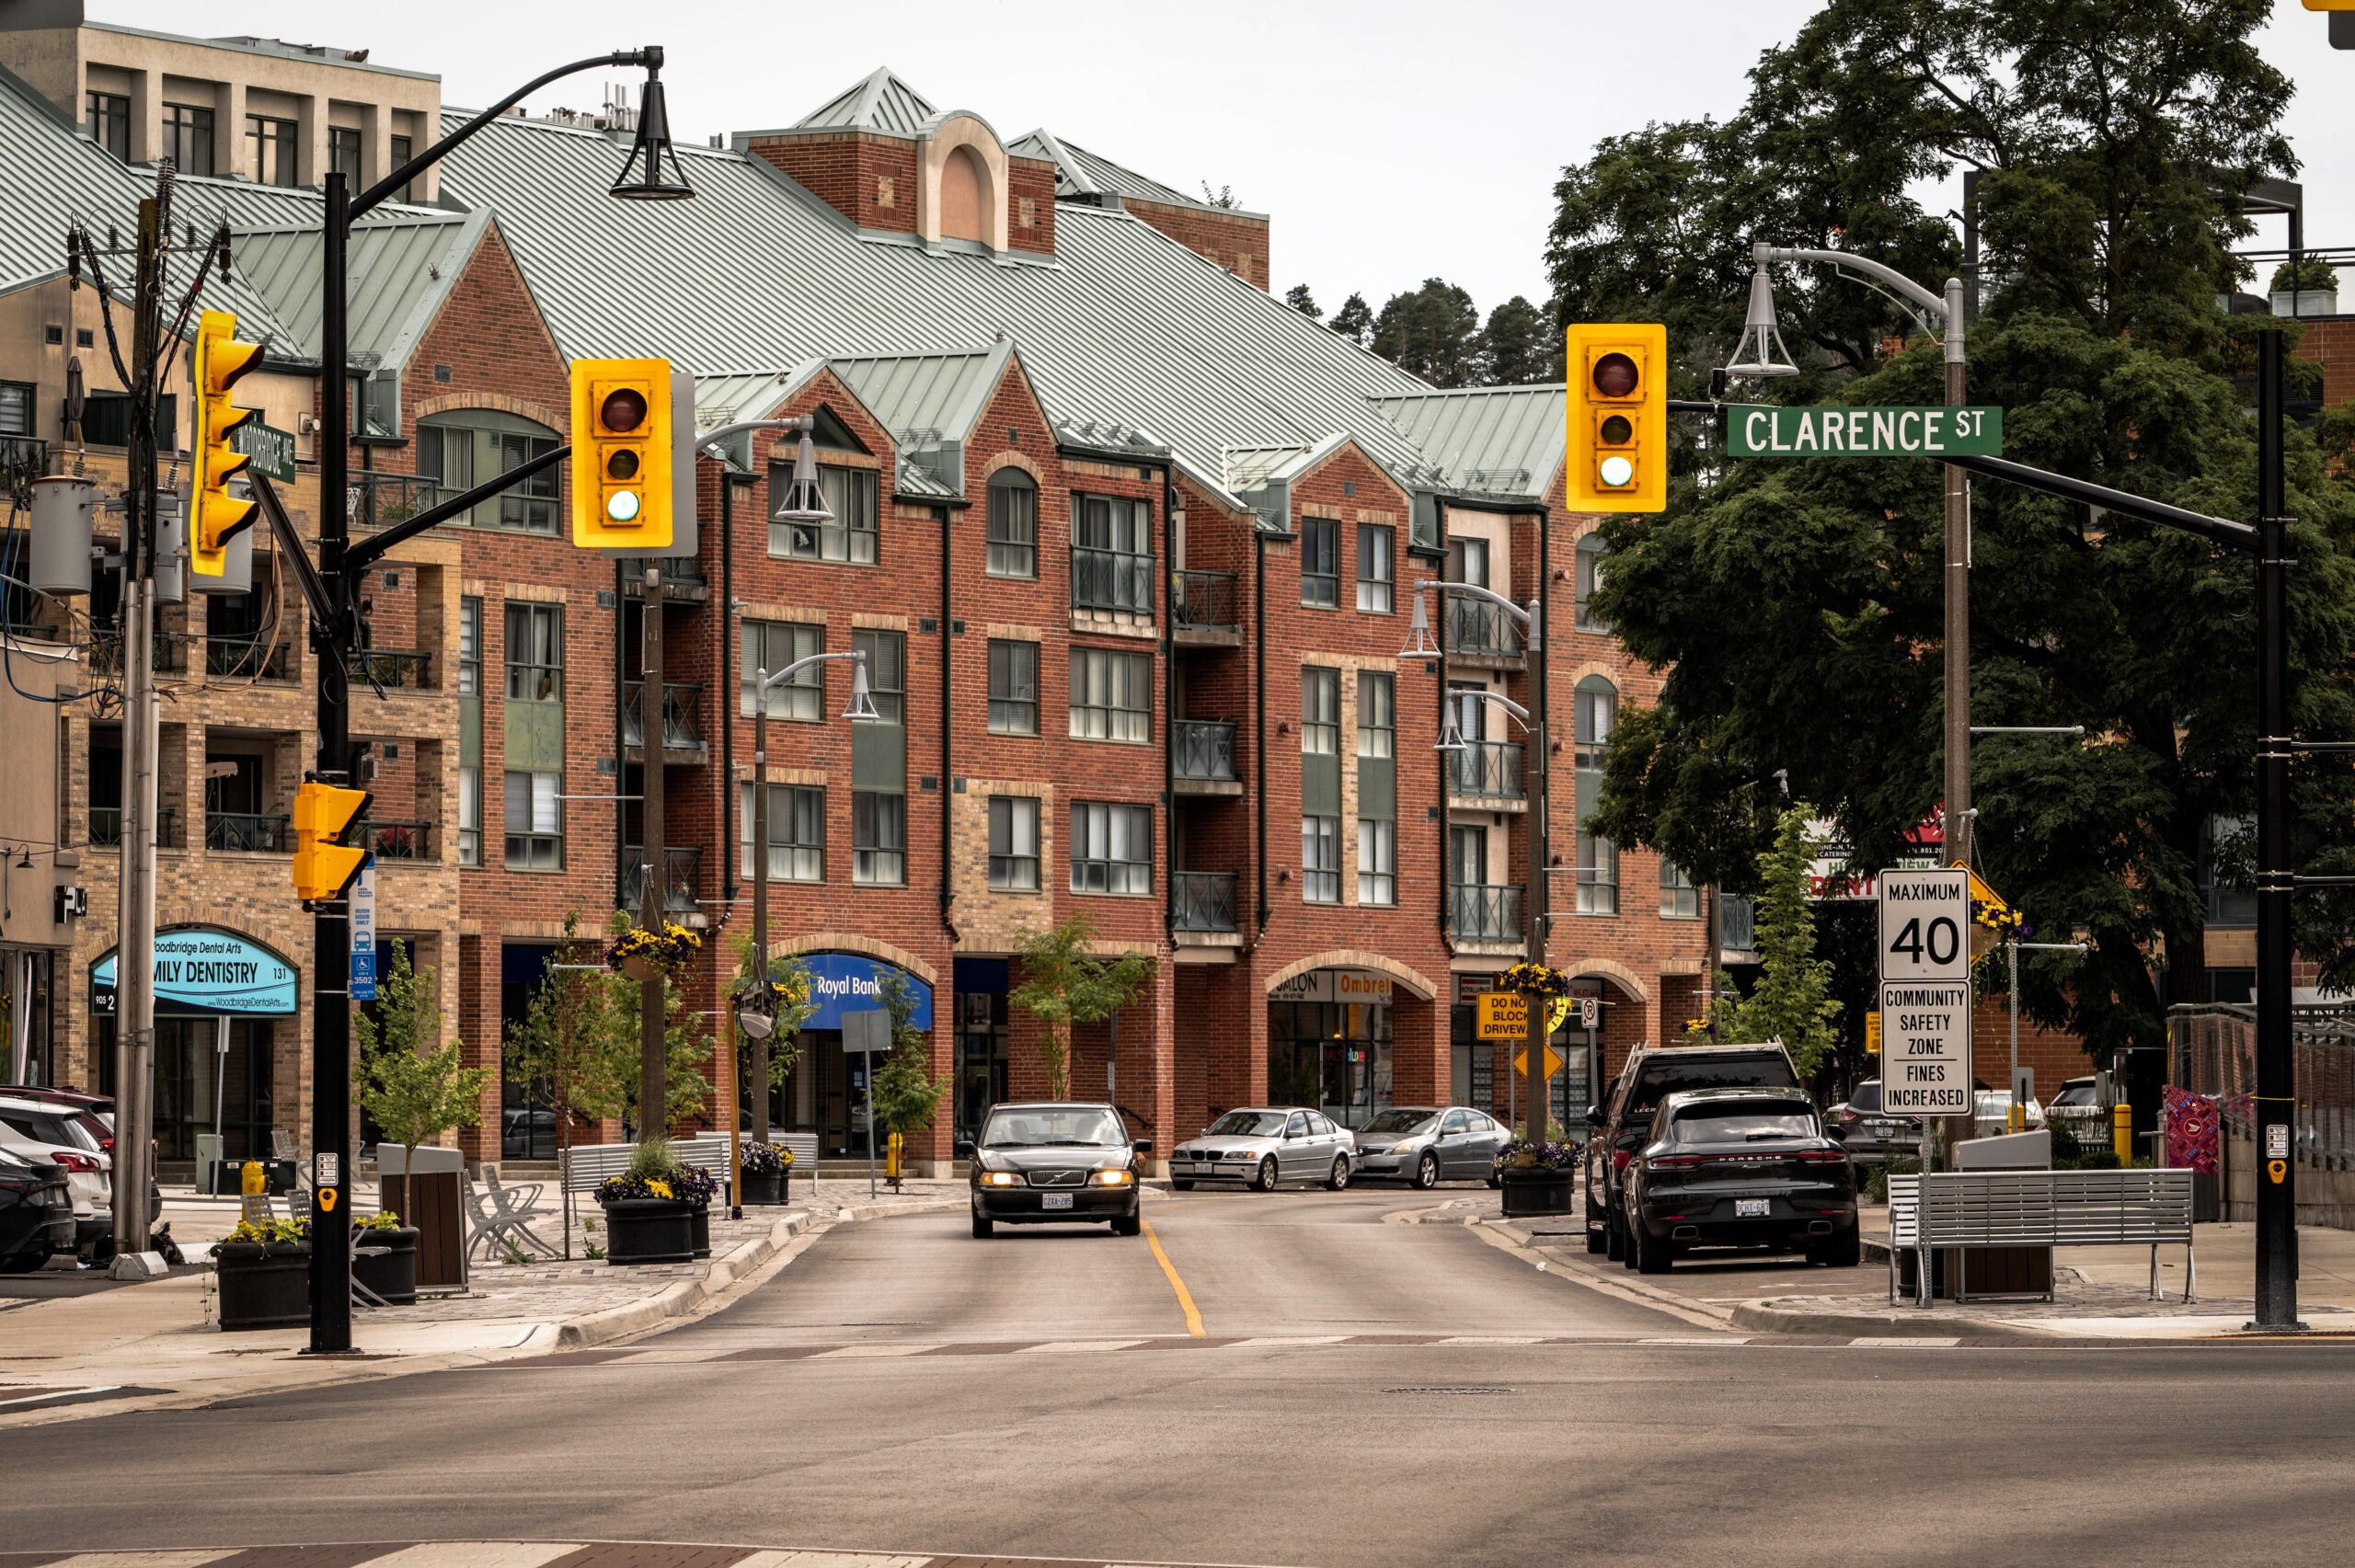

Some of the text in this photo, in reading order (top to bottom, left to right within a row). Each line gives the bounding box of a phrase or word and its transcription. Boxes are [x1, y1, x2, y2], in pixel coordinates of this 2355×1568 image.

[1745, 410, 1985, 452] CLARENCE ST
[1889, 884, 1960, 901] MAXIMUM
[154, 942, 242, 956] oodbridge Dental Arts
[1890, 917, 1959, 966] 40
[153, 961, 286, 984] MILY DENTISTRY 131
[818, 975, 882, 1000] Royal Bank
[96, 995, 107, 1004] 905
[1491, 998, 1527, 1008] DO NO
[1886, 990, 1965, 1006] COMMUNITY
[1484, 1024, 1528, 1035] DRIVEW
[1901, 1014, 1950, 1031] SAFETY
[1908, 1038, 1944, 1055] ZONE
[1907, 1066, 1945, 1082] FINES
[1889, 1090, 1963, 1106] INCREASED
